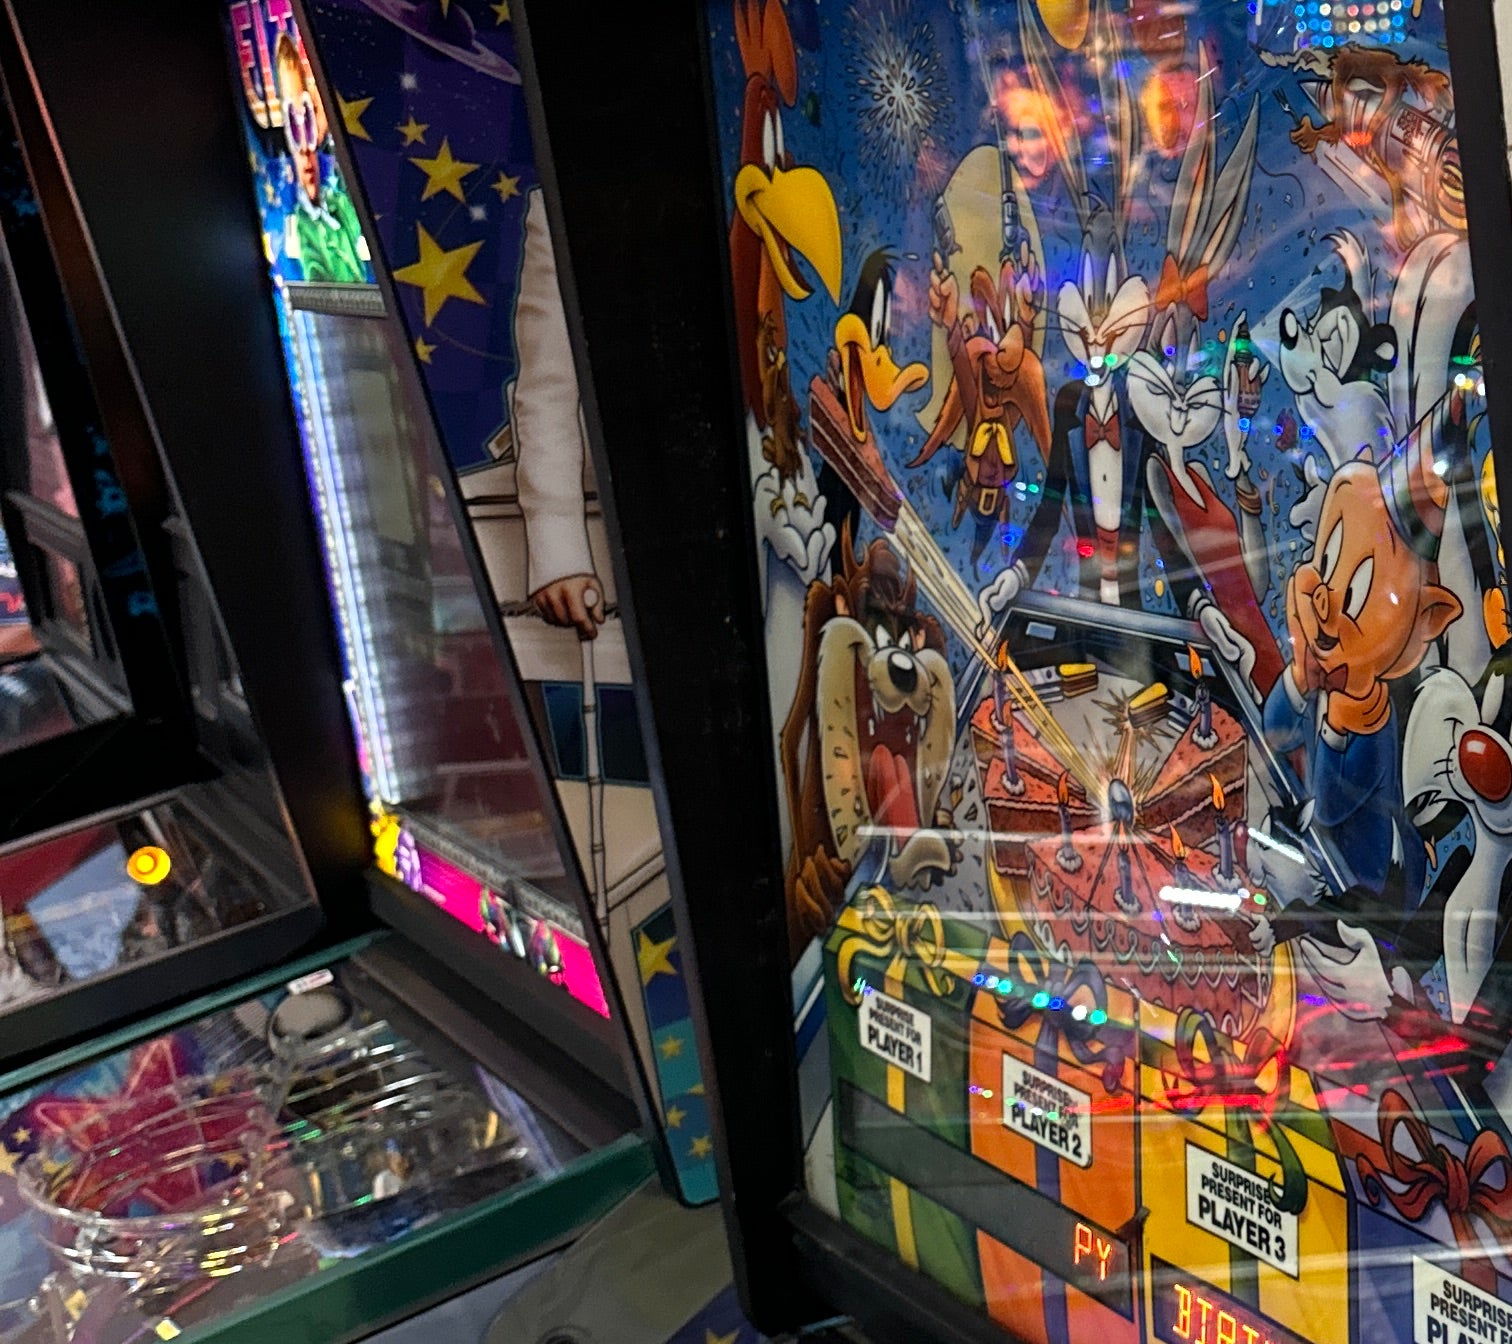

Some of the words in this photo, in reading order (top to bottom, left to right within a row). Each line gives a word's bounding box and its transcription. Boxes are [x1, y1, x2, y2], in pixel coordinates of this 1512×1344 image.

[868, 1023, 915, 1069] PLAYER
[916, 1051, 923, 1073] 1
[1011, 1102, 1070, 1153] PLAYER
[1072, 1133, 1083, 1159] 2
[1201, 1173, 1256, 1216] PRESENT
[1257, 1202, 1283, 1231] FOR
[1211, 1161, 1271, 1206] SURPRISE
[1073, 1222, 1112, 1282] PY
[1198, 1193, 1272, 1256] PLAYER
[1274, 1235, 1286, 1263] 3
[1430, 1292, 1498, 1344] PRESENT
